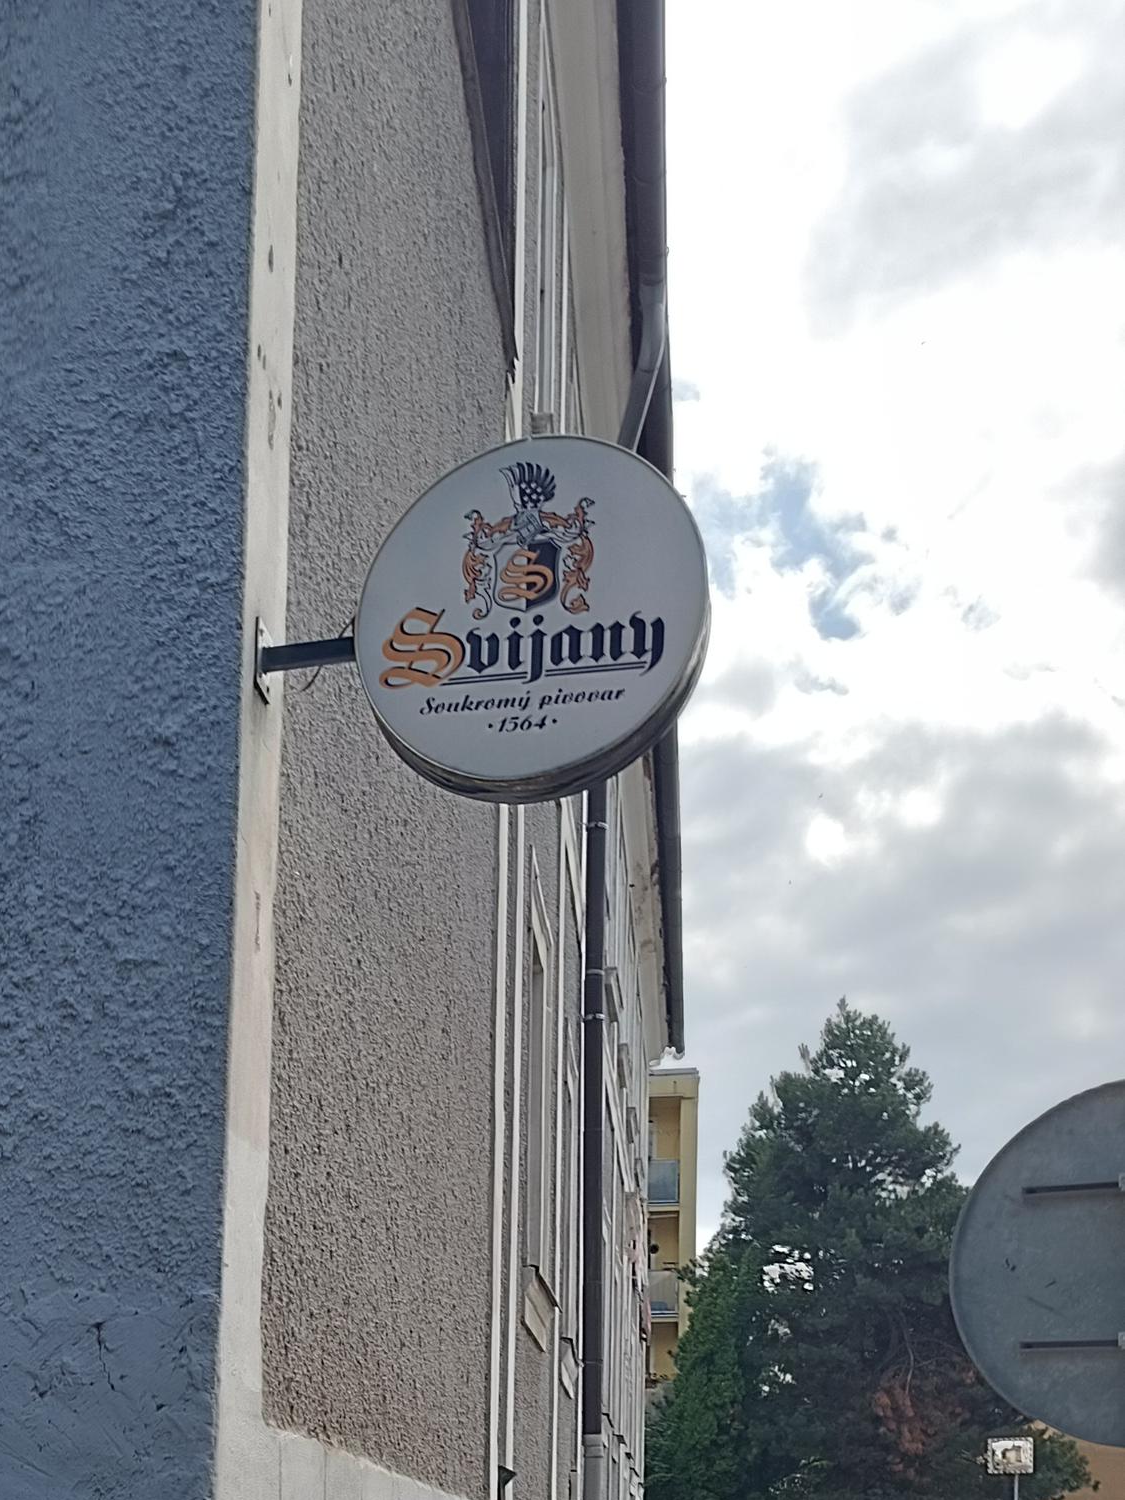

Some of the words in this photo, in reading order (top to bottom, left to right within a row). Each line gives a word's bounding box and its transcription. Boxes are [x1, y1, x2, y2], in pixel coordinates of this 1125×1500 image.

[378, 608, 665, 689] Svijany
[419, 689, 531, 716] Soukromý
[538, 687, 627, 713] pivovar
